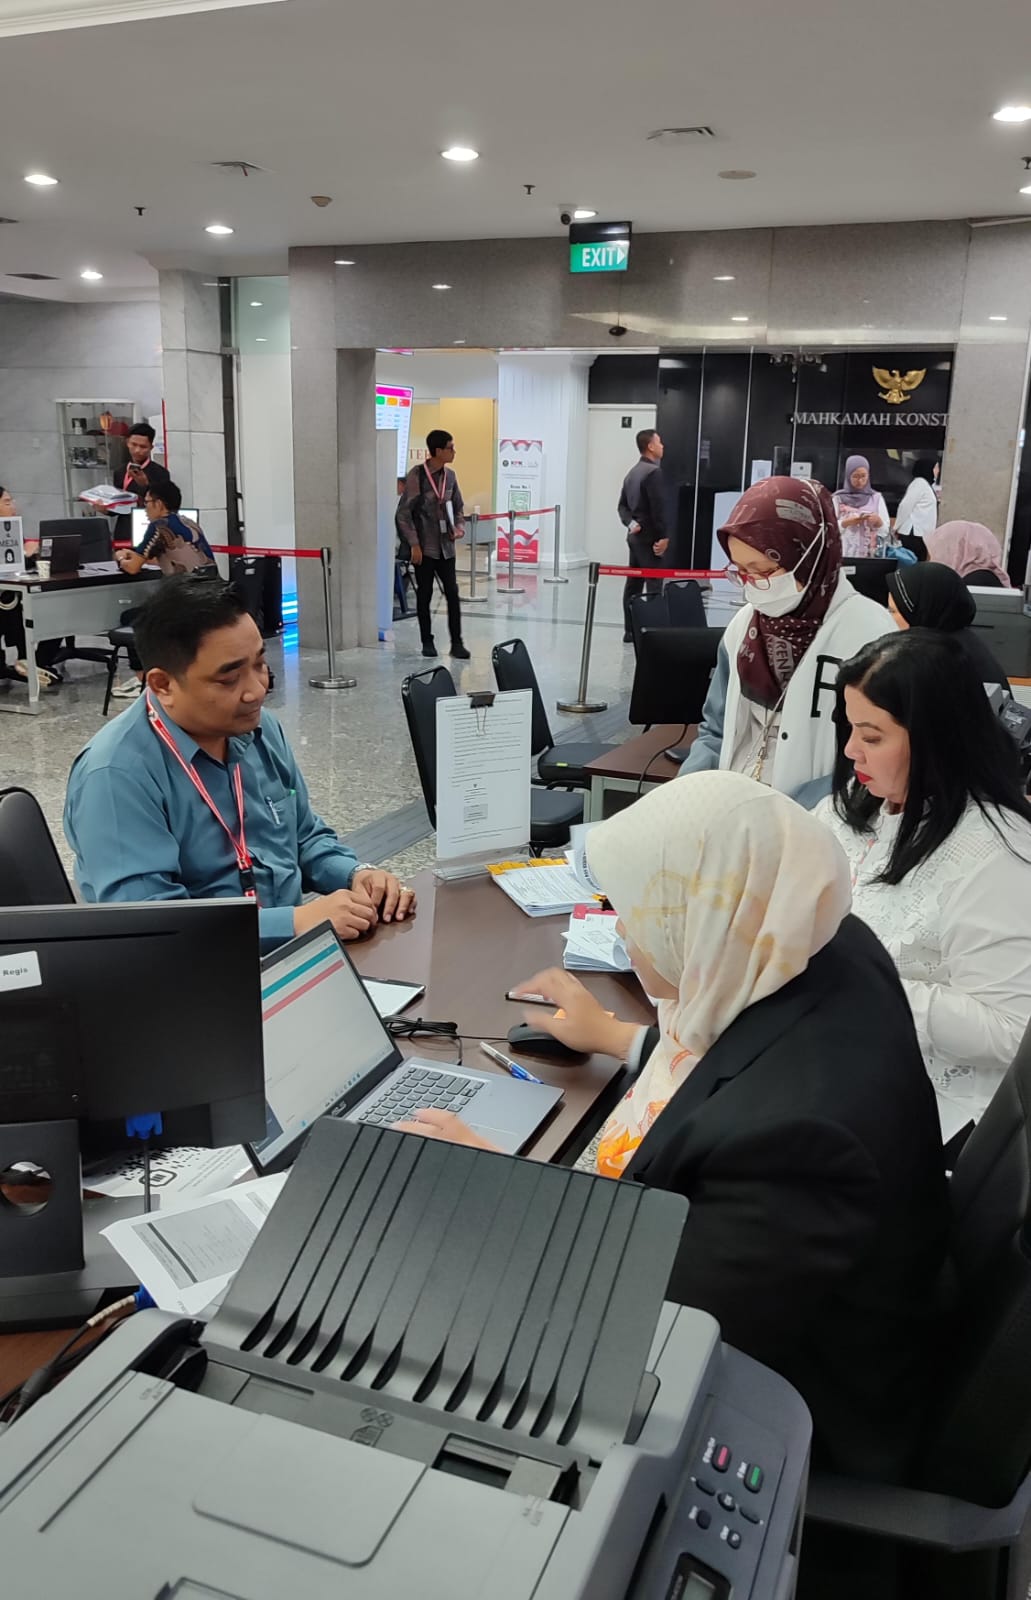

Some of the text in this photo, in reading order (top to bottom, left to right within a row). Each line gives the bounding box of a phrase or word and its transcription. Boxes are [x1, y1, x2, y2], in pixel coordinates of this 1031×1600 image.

[582, 247, 617, 267] EXIT
[793, 411, 890, 426] MAHKAMAH
[3, 967, 29, 977] Regis
